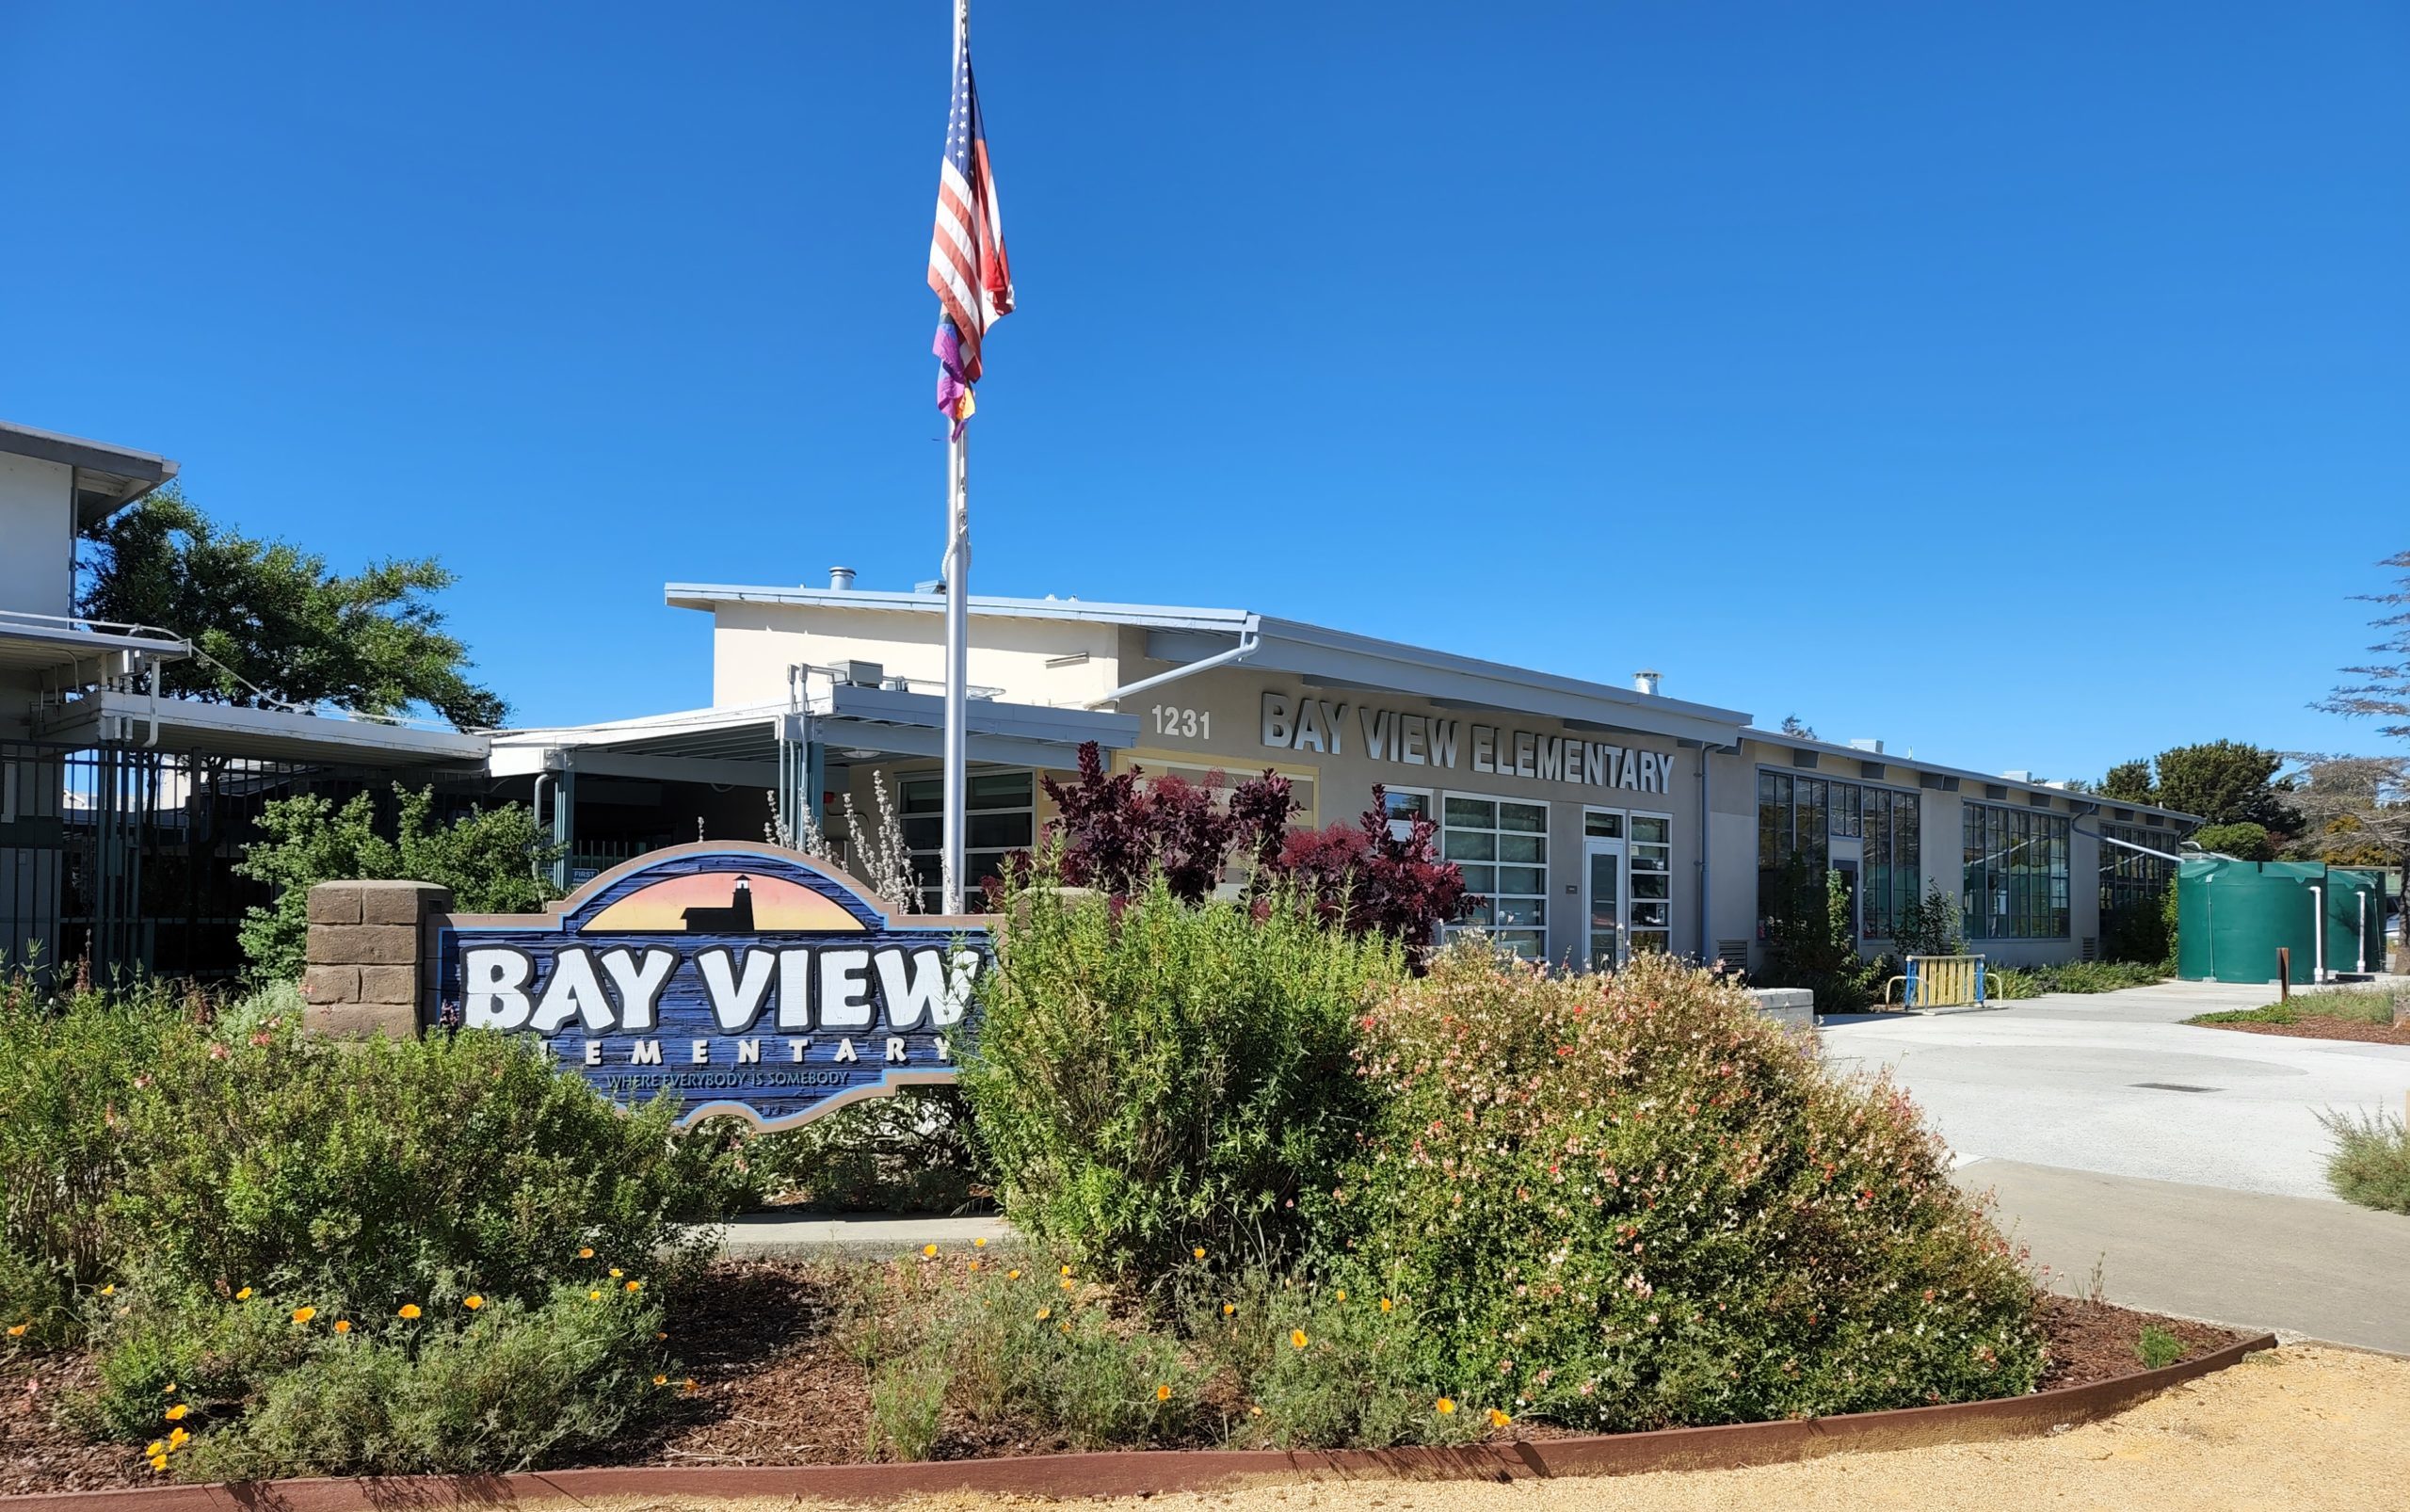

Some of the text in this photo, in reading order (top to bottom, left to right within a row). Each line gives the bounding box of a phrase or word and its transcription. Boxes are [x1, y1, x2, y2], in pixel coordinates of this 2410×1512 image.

[1151, 704, 1211, 740] 1231
[1261, 691, 1675, 795] BAY VIEW ELEMENTARY
[462, 944, 985, 1035] BAY VIEW
[537, 1037, 952, 1065] EMENTARY
[606, 1070, 849, 1090] WHERE EVERYBODY IS SOMEBODY
